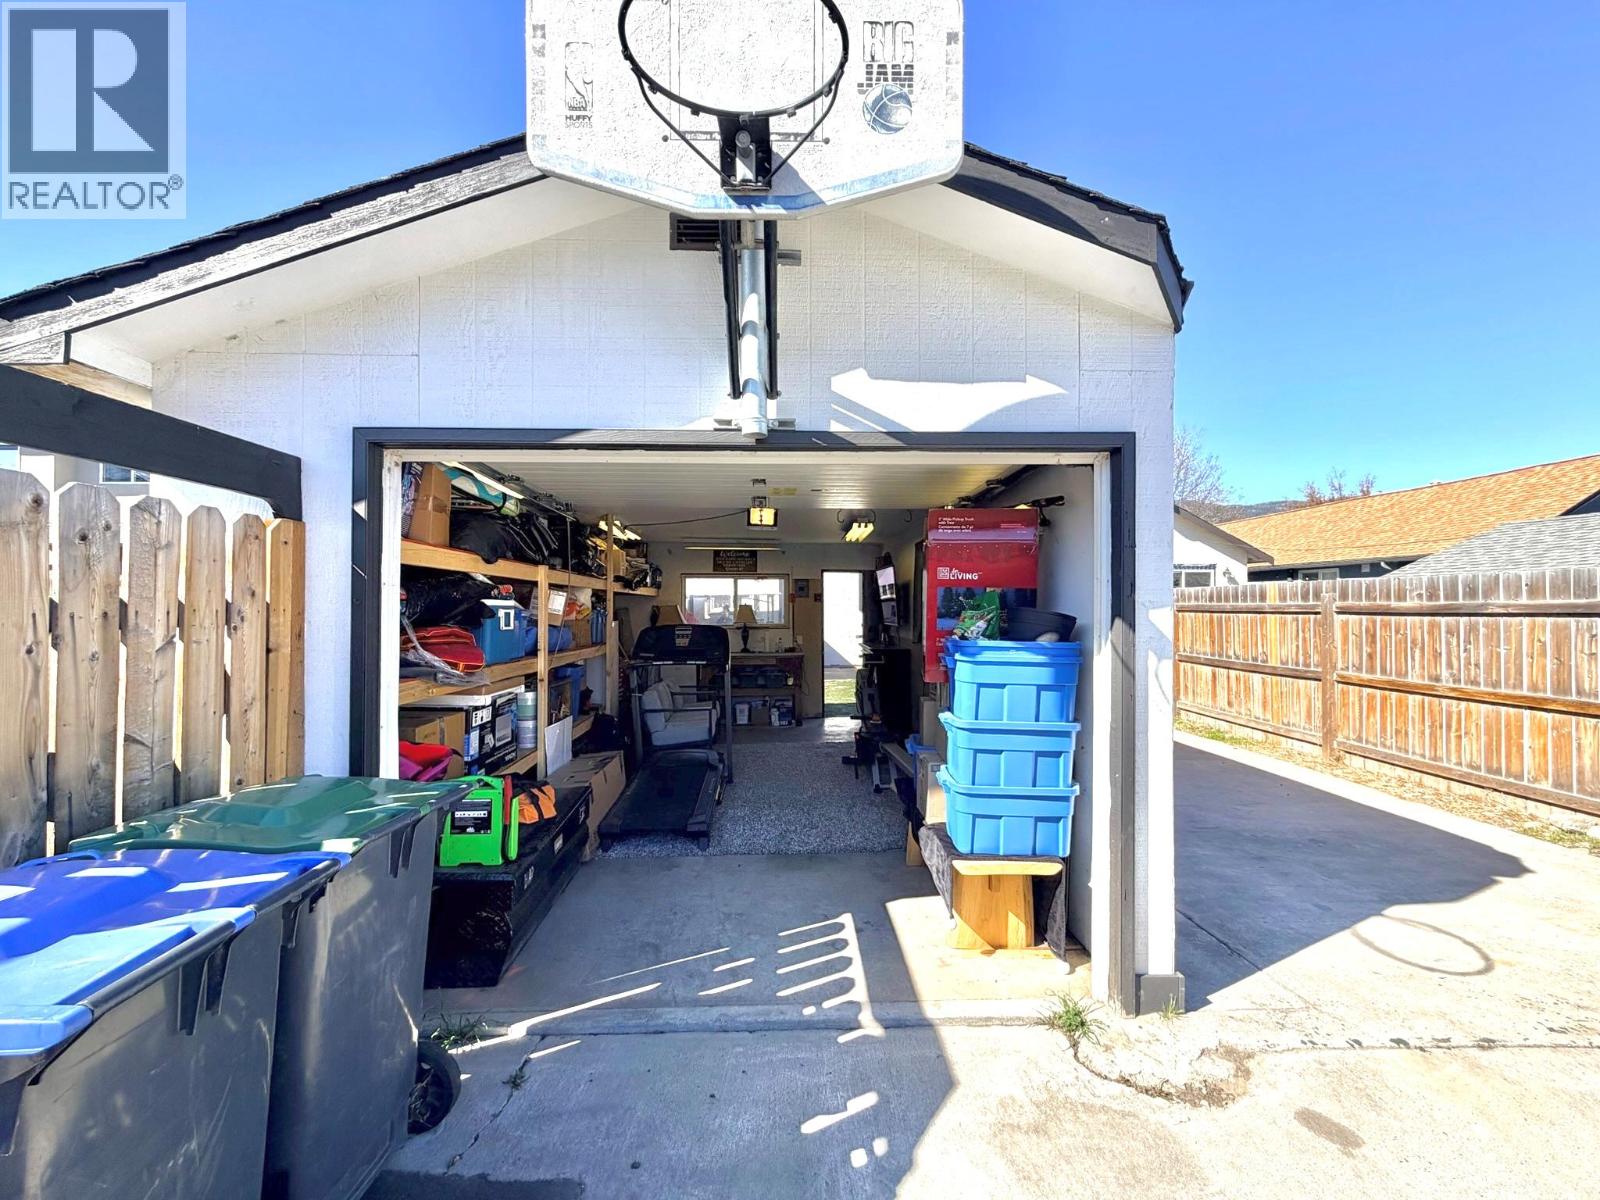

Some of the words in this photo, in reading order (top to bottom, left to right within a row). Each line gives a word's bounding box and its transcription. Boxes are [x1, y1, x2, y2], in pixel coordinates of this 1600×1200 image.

[863, 20, 915, 63] BIG
[564, 114, 593, 122] HUFFY
[564, 121, 593, 129] SPORTS
[950, 571, 979, 580] LIVING
